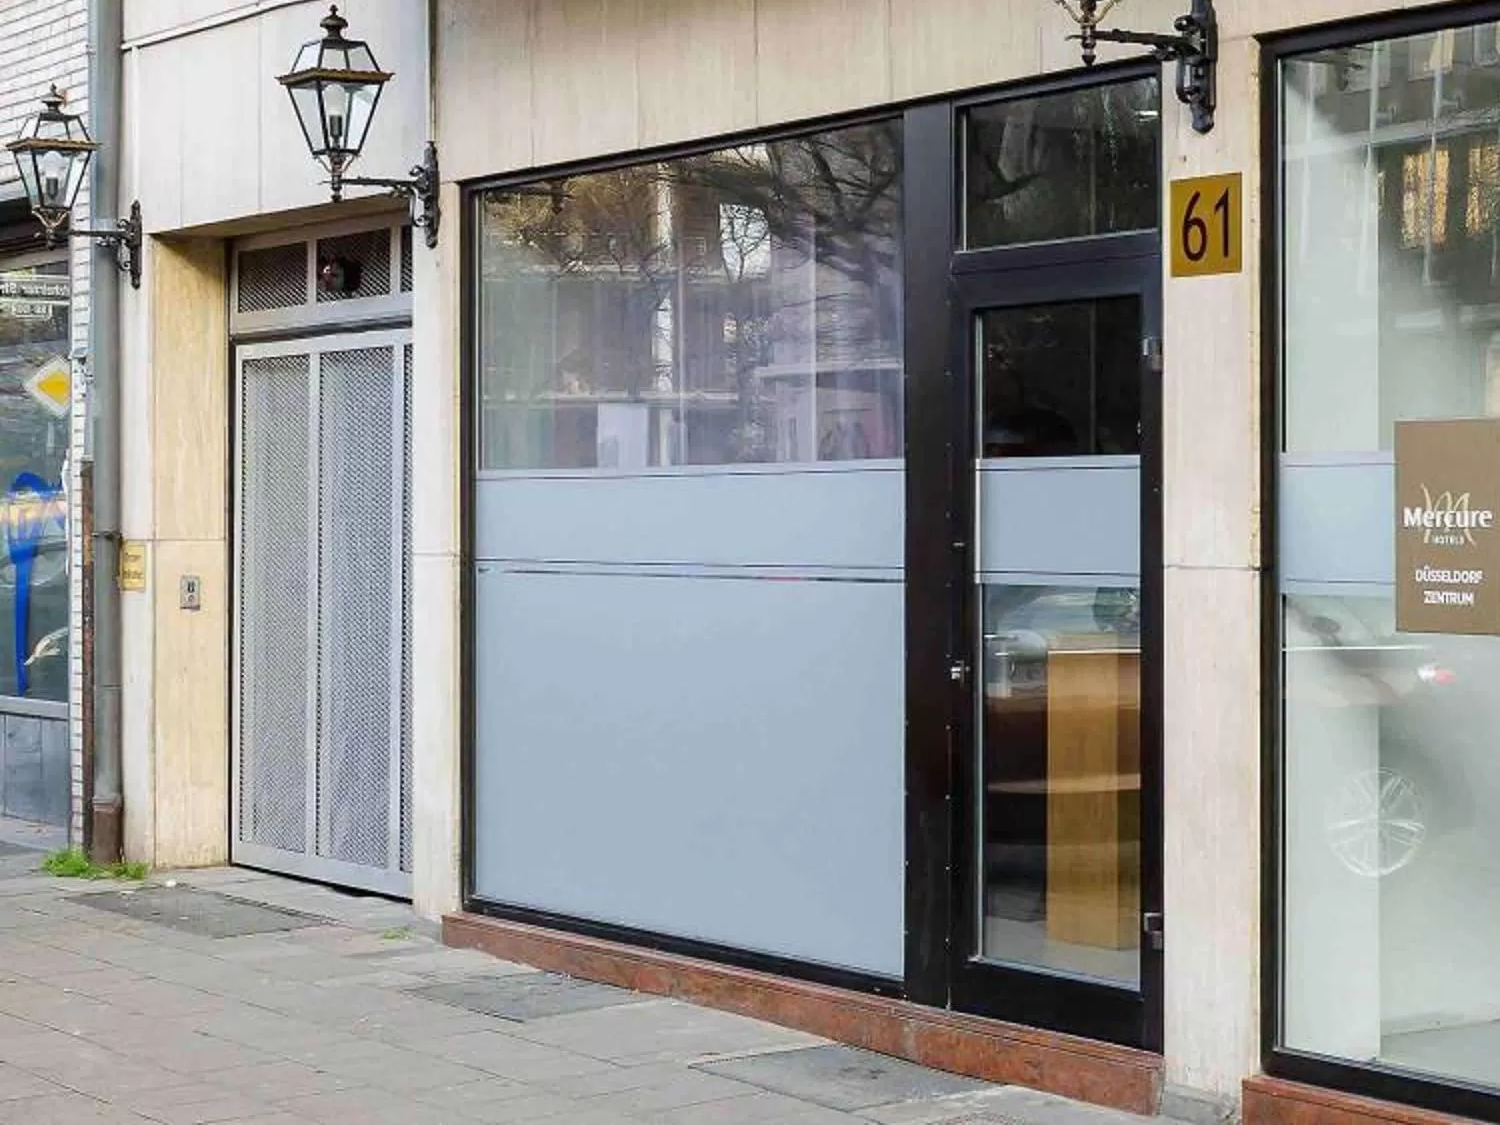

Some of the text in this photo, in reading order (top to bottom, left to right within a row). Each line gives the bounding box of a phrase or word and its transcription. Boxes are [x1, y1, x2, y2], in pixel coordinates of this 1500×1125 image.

[1182, 186, 1229, 262] 61
[1403, 506, 1493, 529] Mercure
[1415, 565, 1483, 584] DÜSSELDORF
[1423, 590, 1474, 606] ZENTRUM
